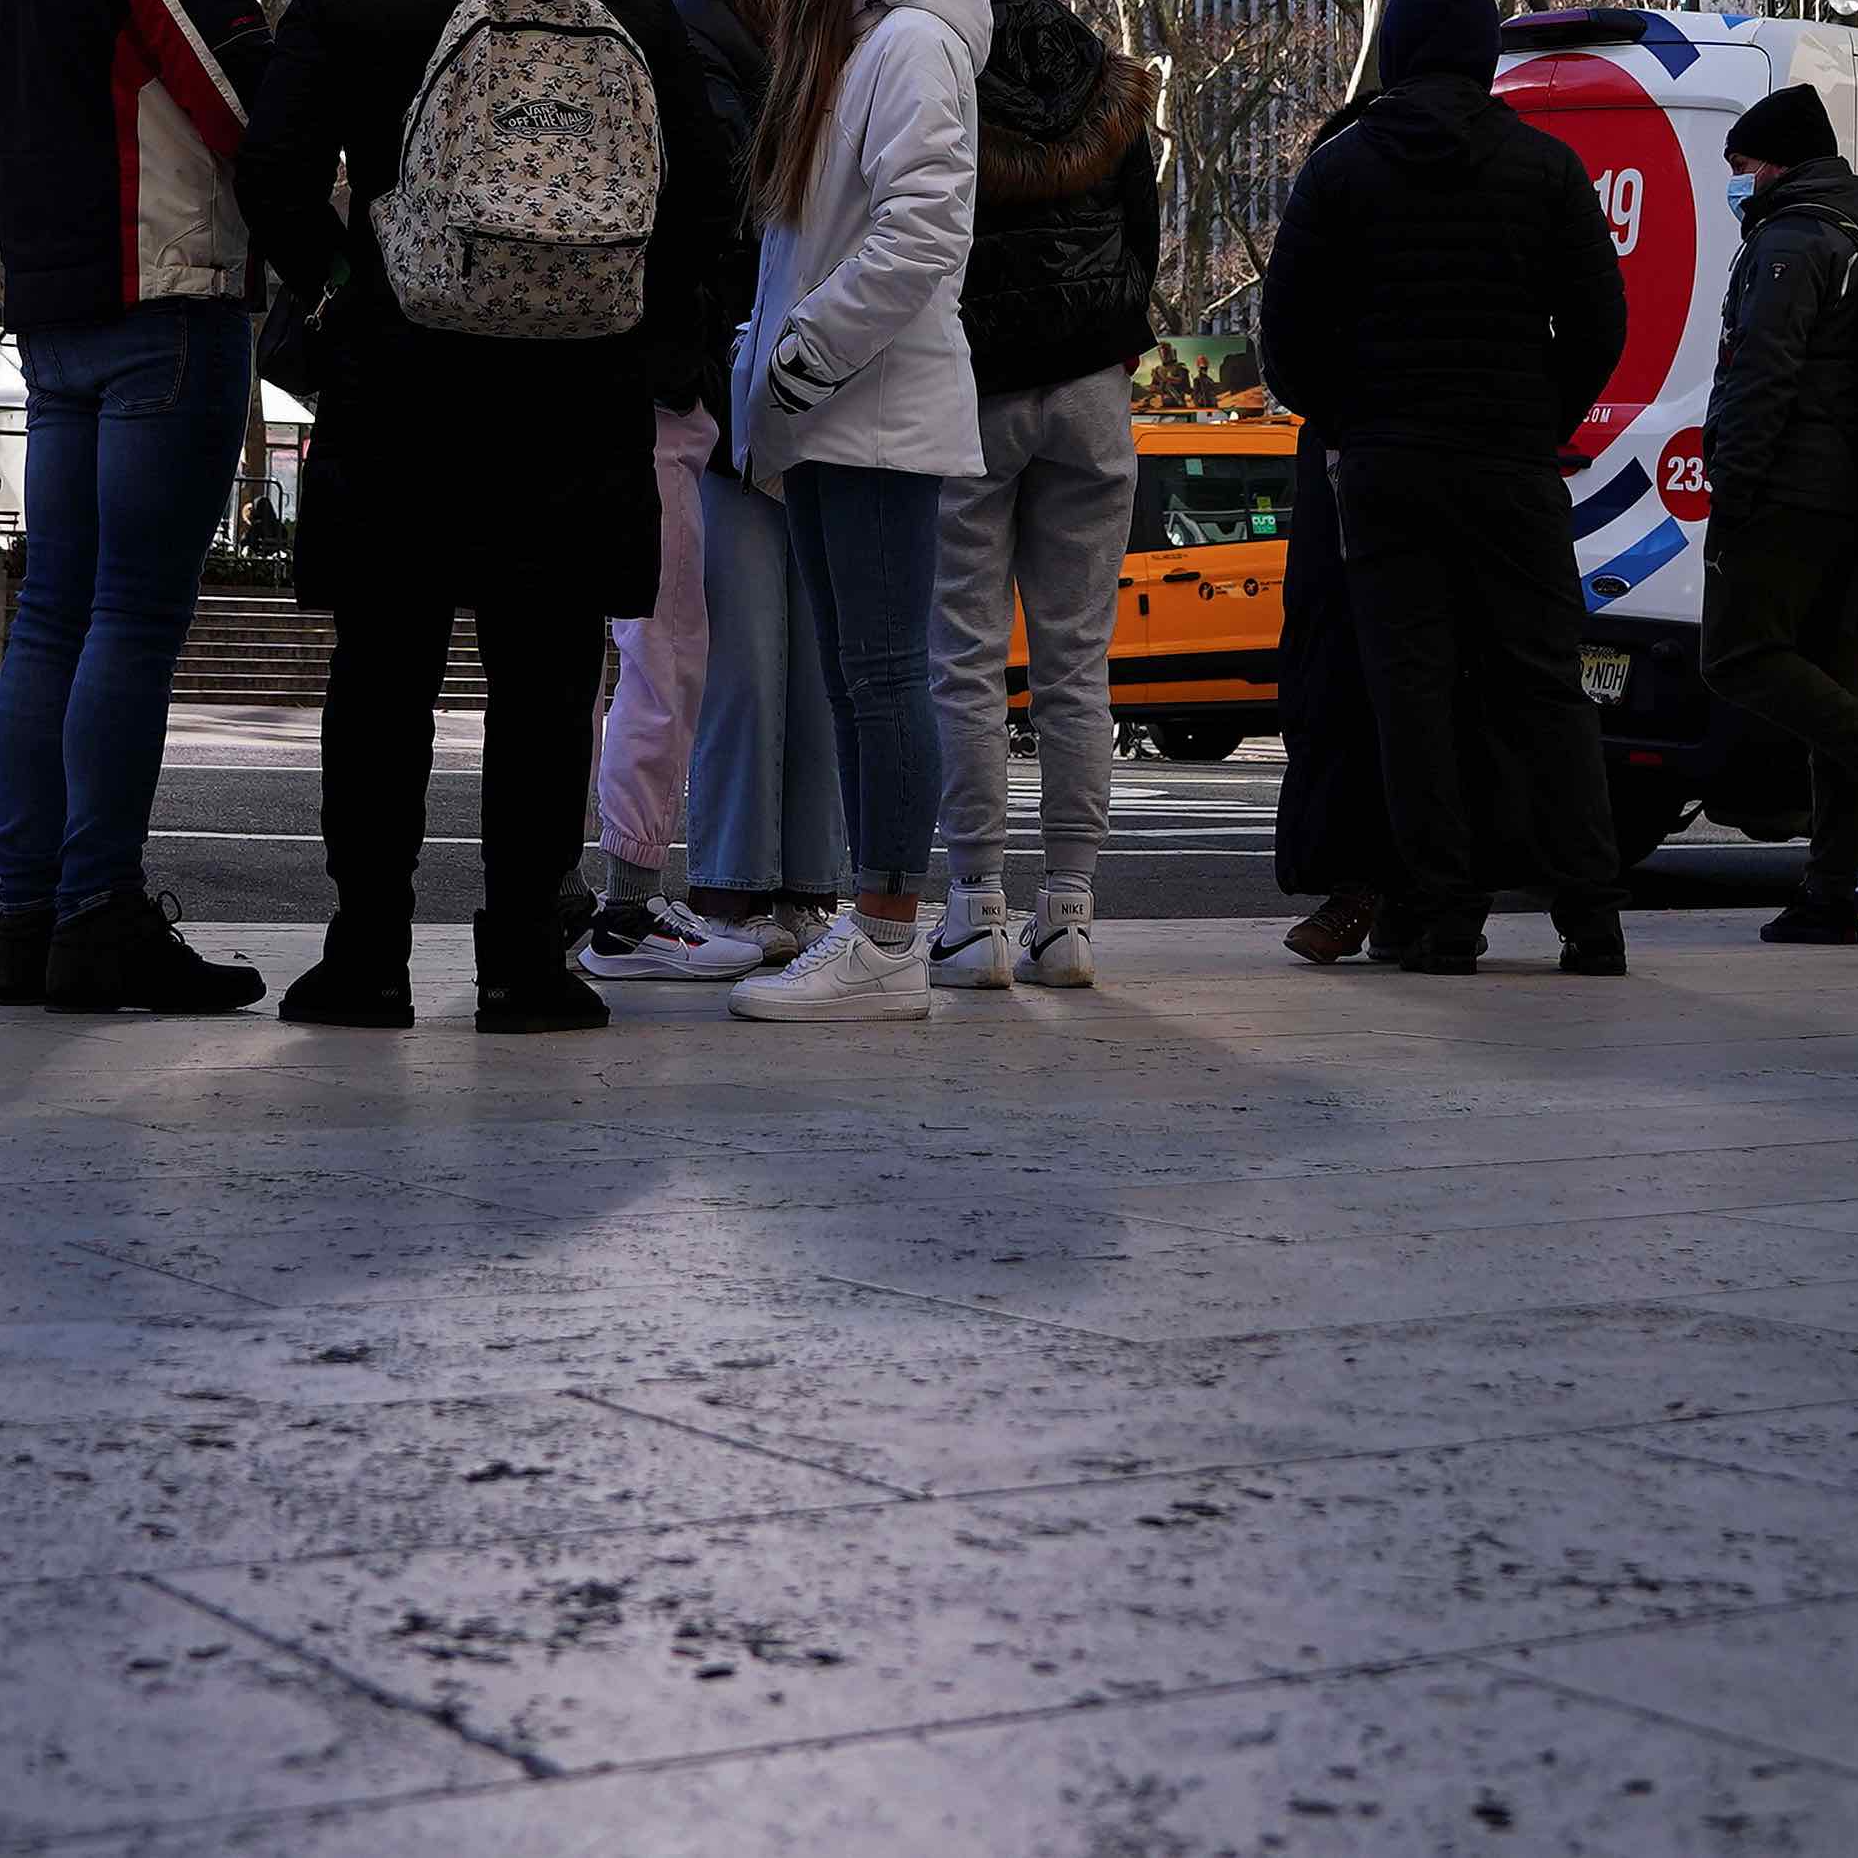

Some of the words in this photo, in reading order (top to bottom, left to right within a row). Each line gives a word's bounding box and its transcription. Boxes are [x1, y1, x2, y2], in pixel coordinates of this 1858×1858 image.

[522, 102, 558, 116] VANS
[531, 113, 558, 127] THE
[557, 112, 584, 127] WALL
[982, 905, 1001, 916] NIKE
[1061, 902, 1084, 915] NIKE
